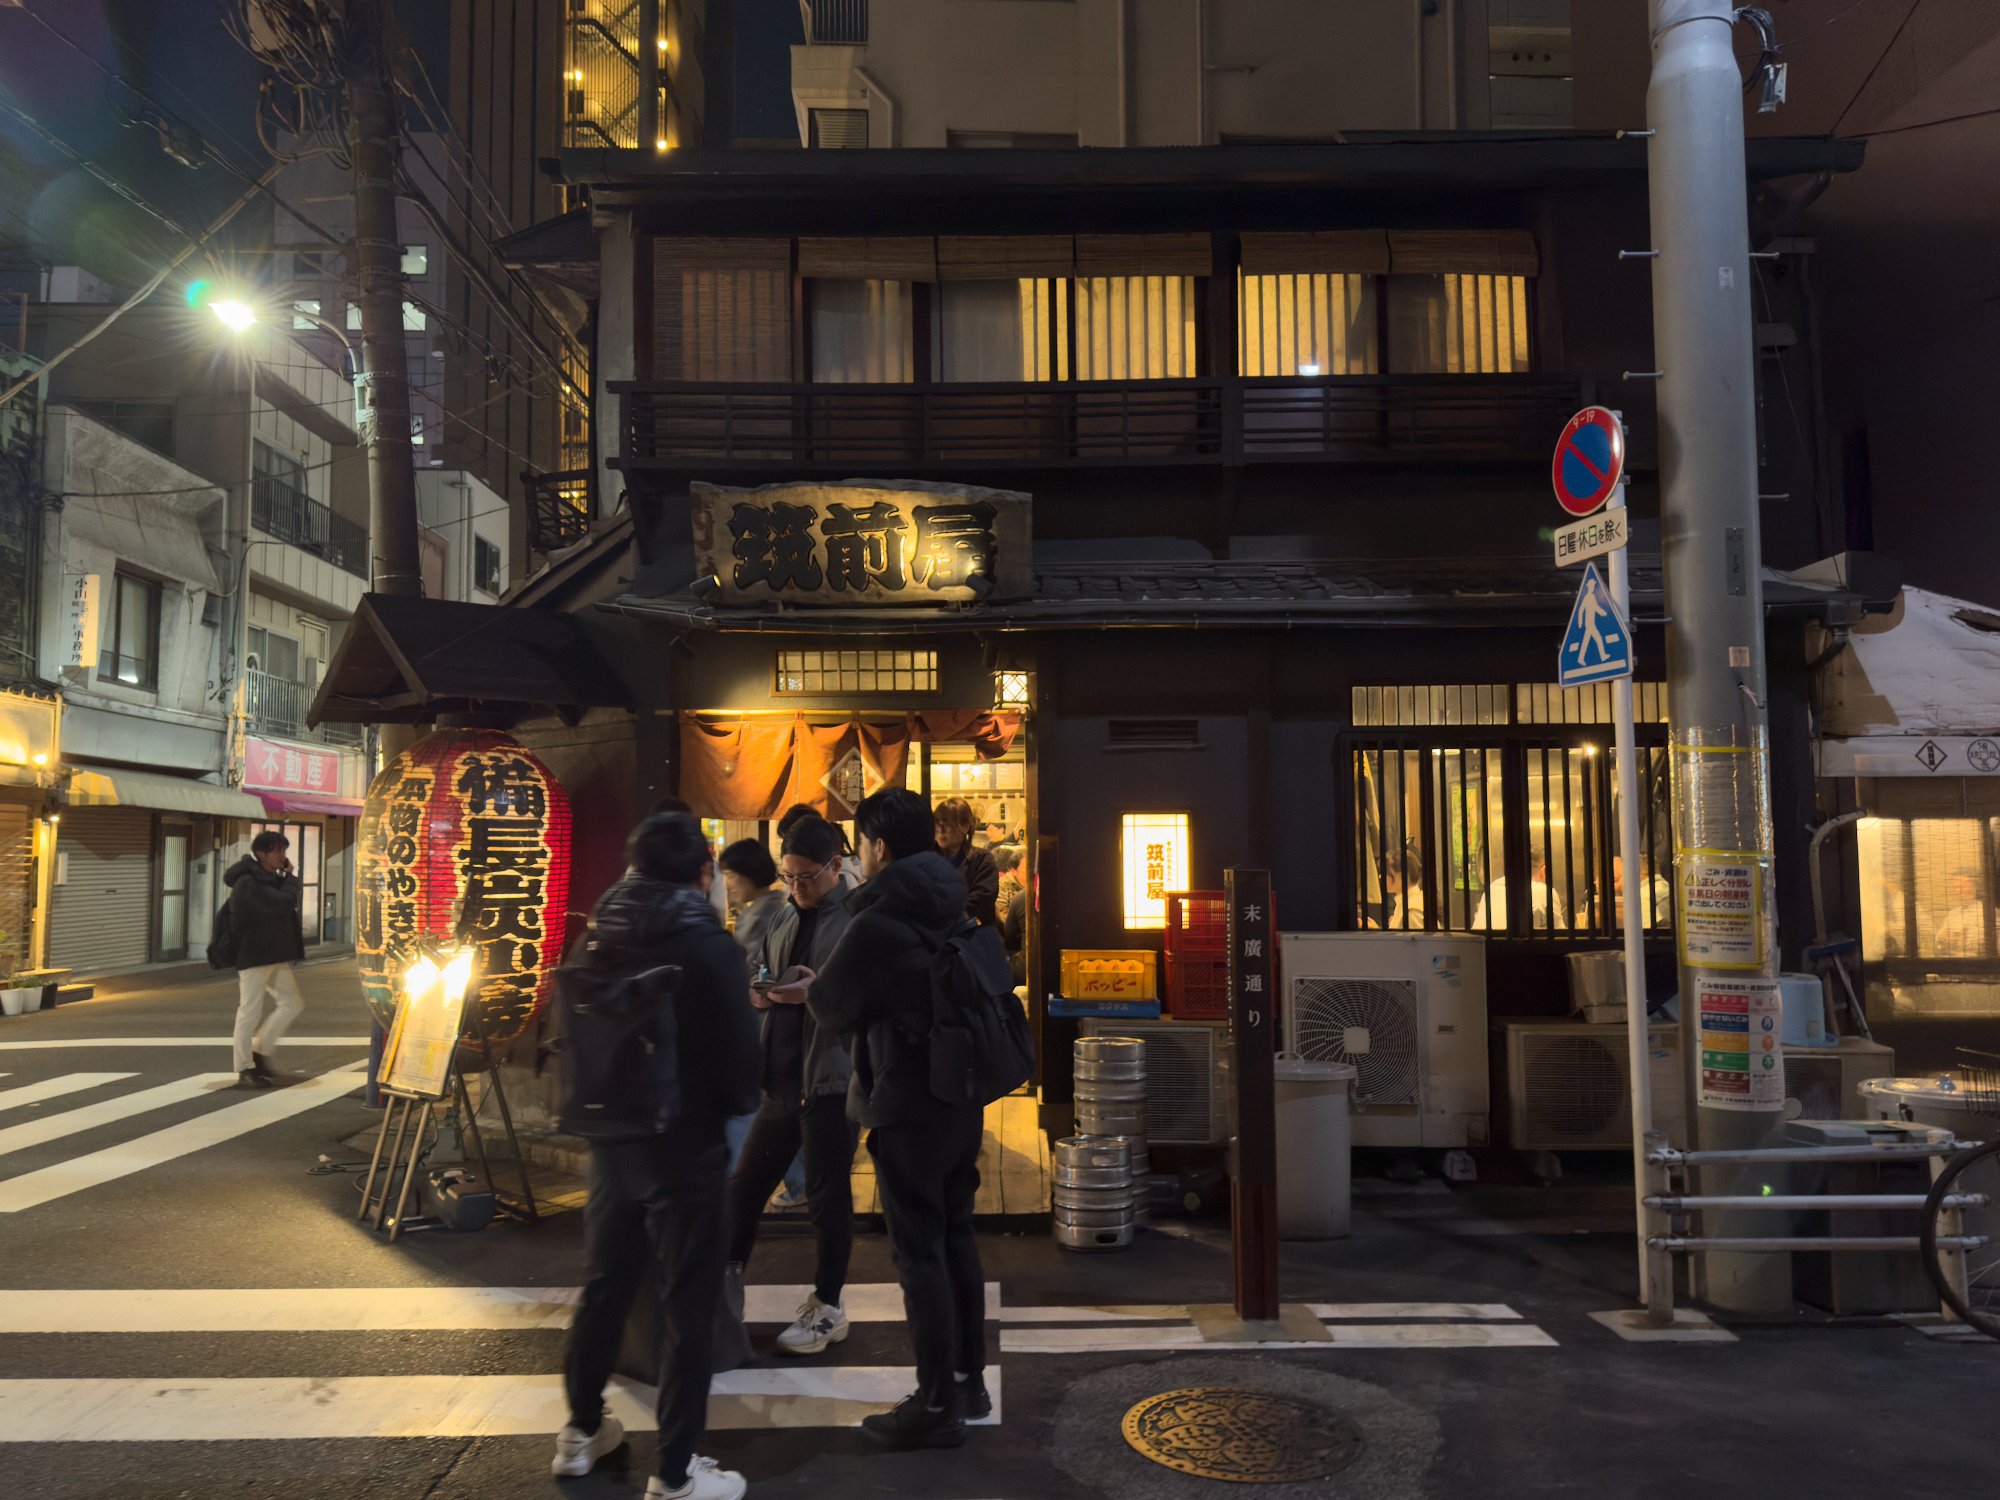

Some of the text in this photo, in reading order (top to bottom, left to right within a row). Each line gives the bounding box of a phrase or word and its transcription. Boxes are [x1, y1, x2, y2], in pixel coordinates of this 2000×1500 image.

[1573, 410, 1595, 429] 9-19
[728, 500, 997, 592] 筑前屋
[1558, 519, 1622, 558] 日曜・休日を除く
[262, 745, 322, 786] 不動産
[1146, 843, 1165, 900] 筑前屋
[1243, 903, 1263, 1027] 末廣通り
